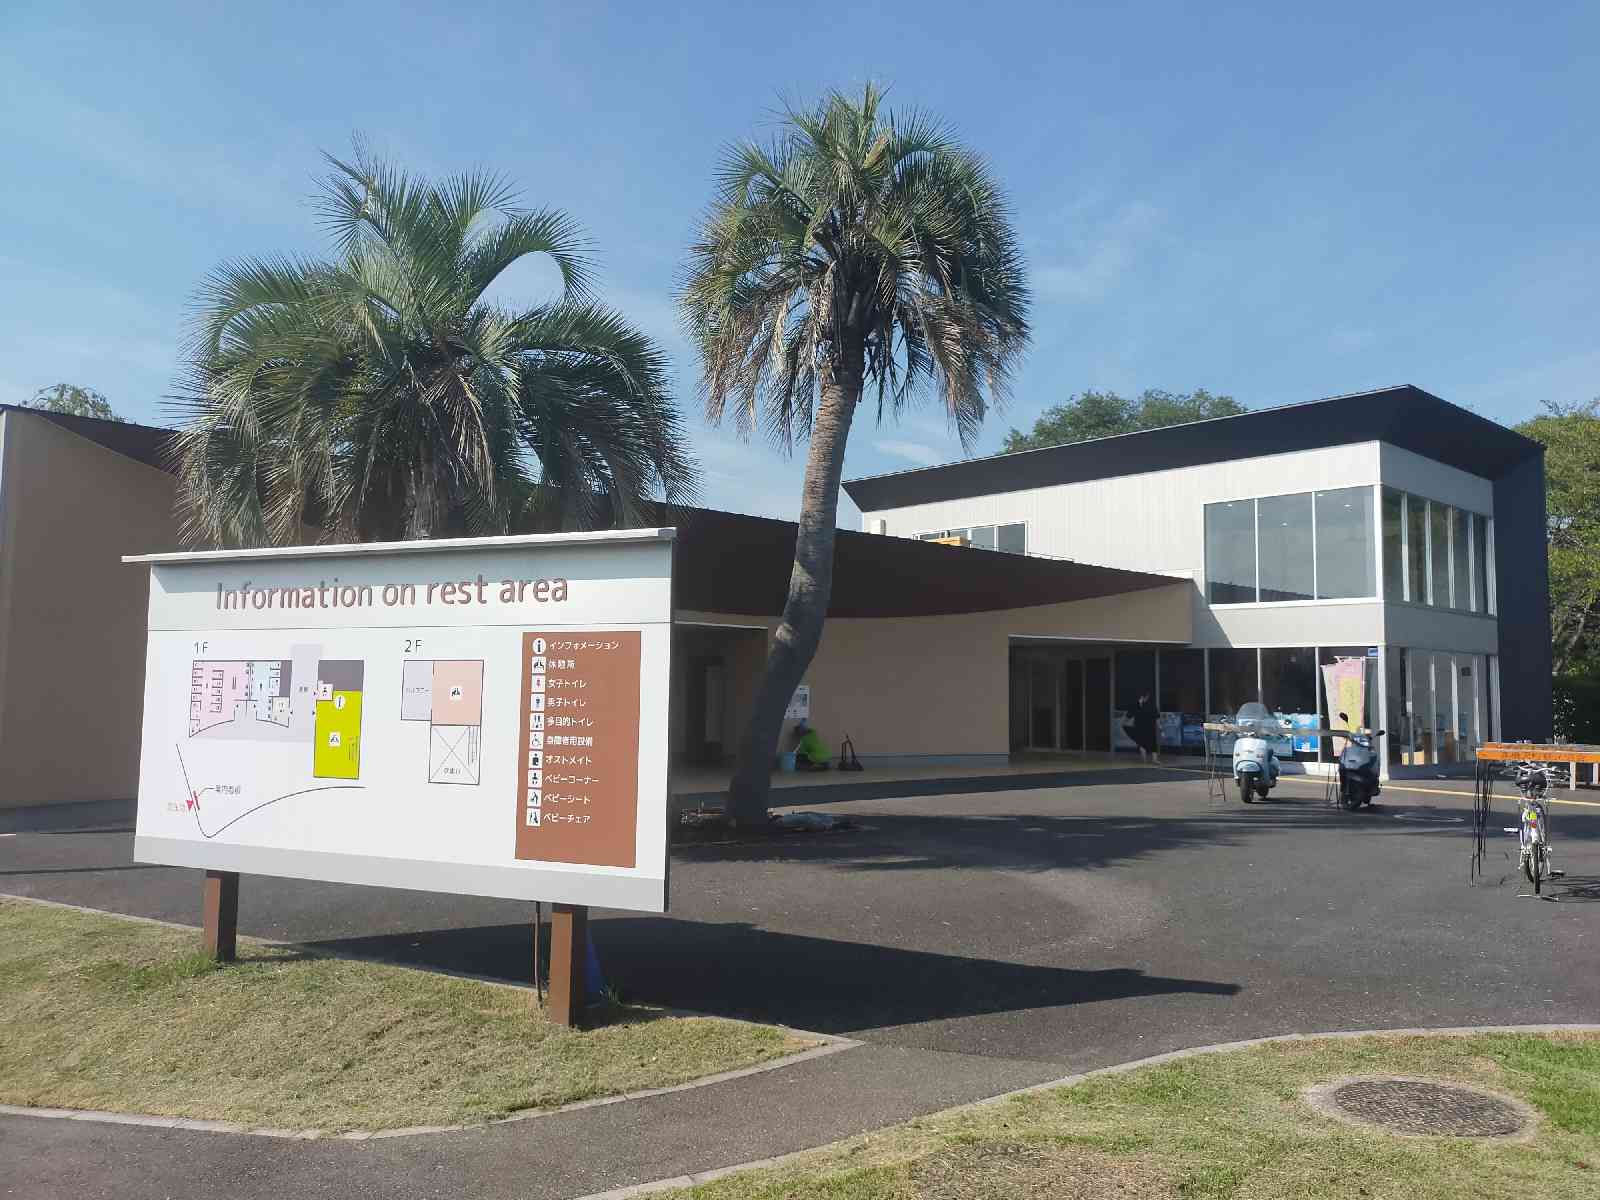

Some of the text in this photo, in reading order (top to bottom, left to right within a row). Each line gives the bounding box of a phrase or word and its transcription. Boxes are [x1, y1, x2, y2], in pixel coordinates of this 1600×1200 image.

[216, 573, 568, 610] Information on rest area
[194, 641, 208, 655] 1F
[403, 639, 422, 653] 2F
[550, 641, 620, 650] インフォメーション
[548, 679, 587, 688] 女子トイレ
[547, 698, 586, 707] 男子トイレ
[547, 717, 593, 727] 多目的トイレ
[545, 755, 592, 764] オストメイト
[544, 774, 600, 784] ベビーコーナー
[544, 793, 591, 804] ベビーシート
[543, 813, 591, 823] ベビーチェア
